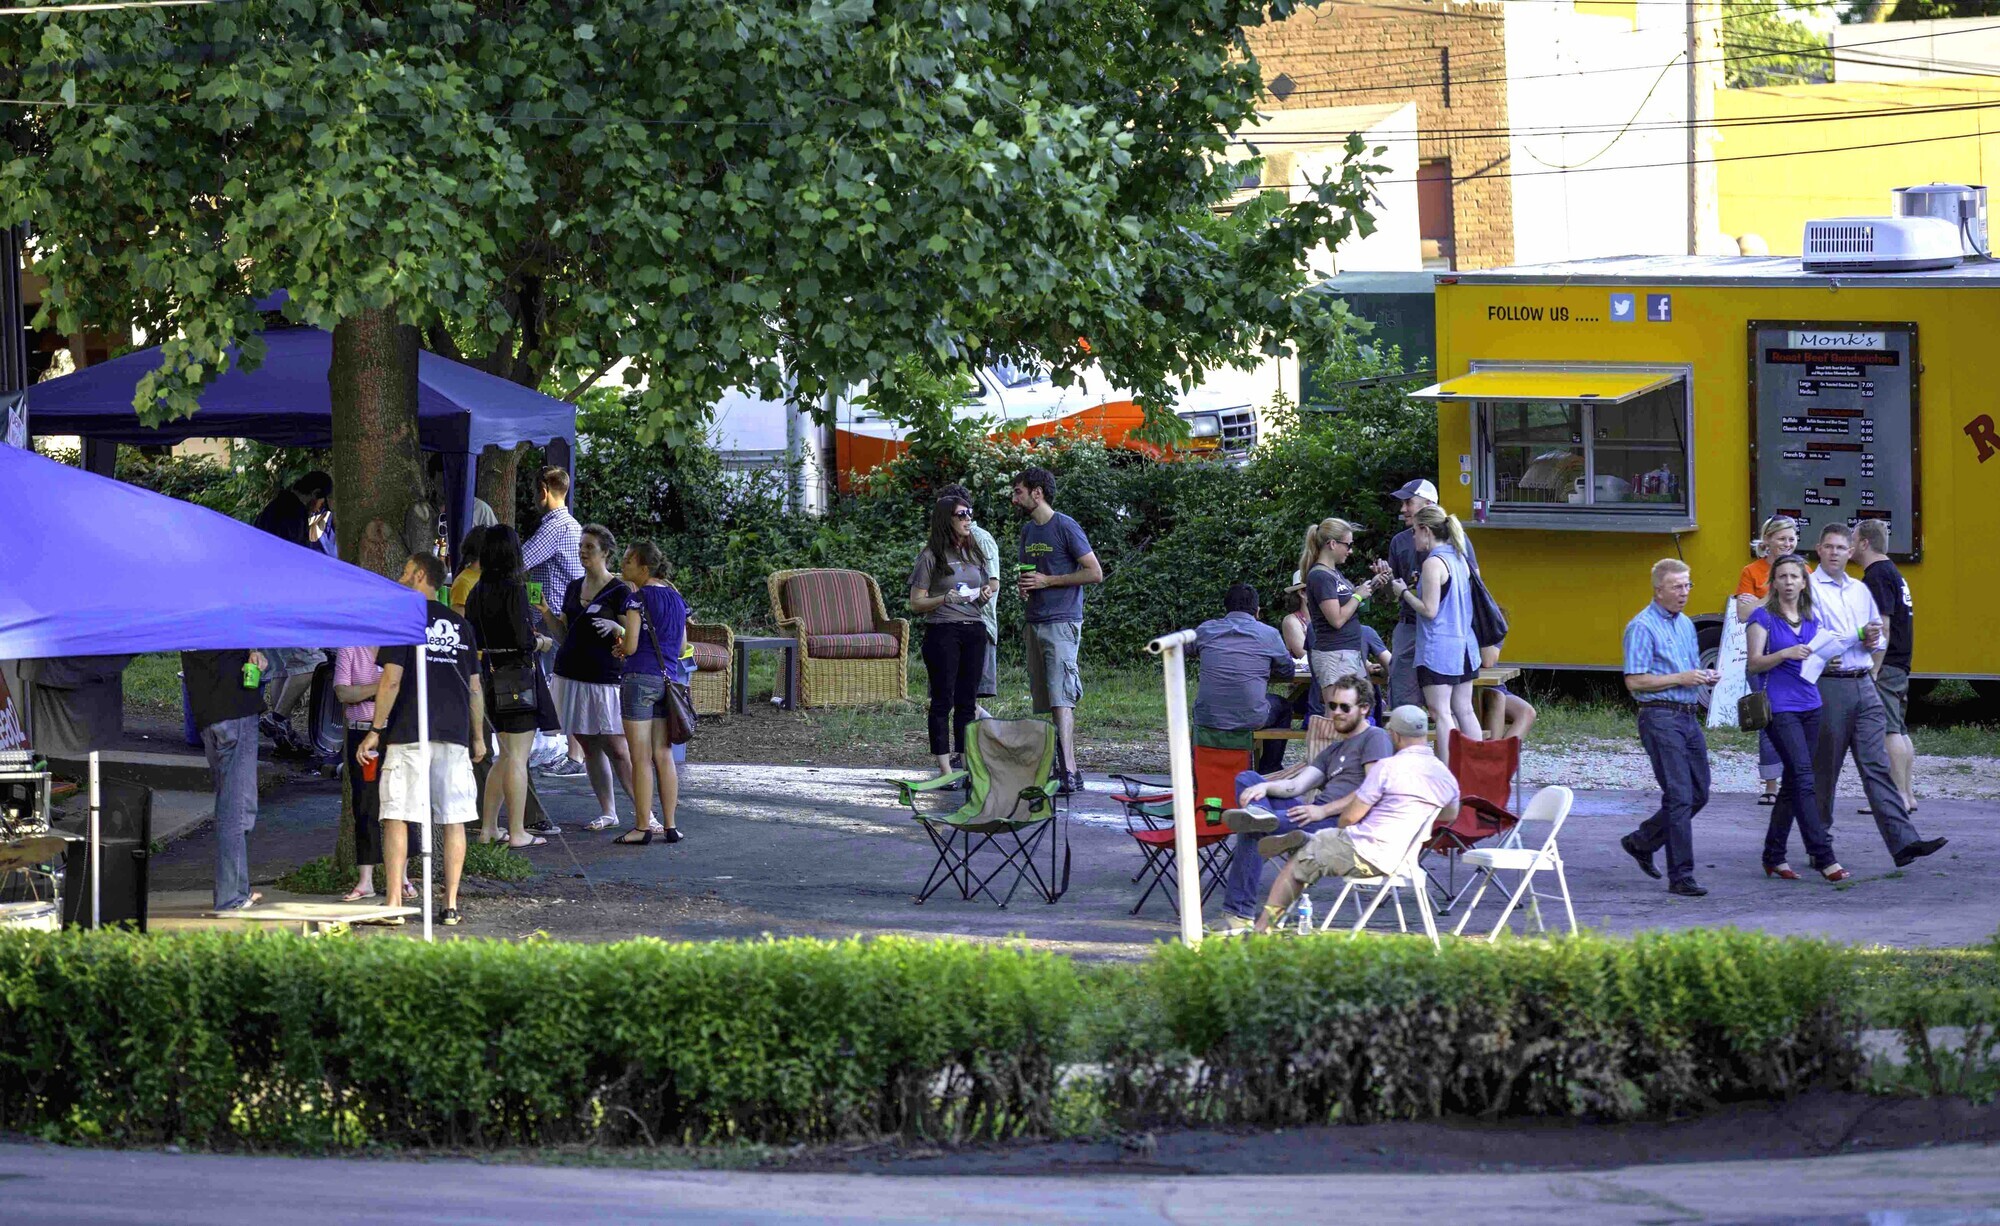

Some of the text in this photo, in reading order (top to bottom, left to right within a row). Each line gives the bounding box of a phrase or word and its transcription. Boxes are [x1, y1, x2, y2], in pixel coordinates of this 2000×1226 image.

[1488, 306, 1544, 321] FOLLOW
[1550, 308, 1569, 321] US
[1800, 333, 1878, 347] Monk's
[1772, 352, 1893, 364] Roast Beef Sandwiches
